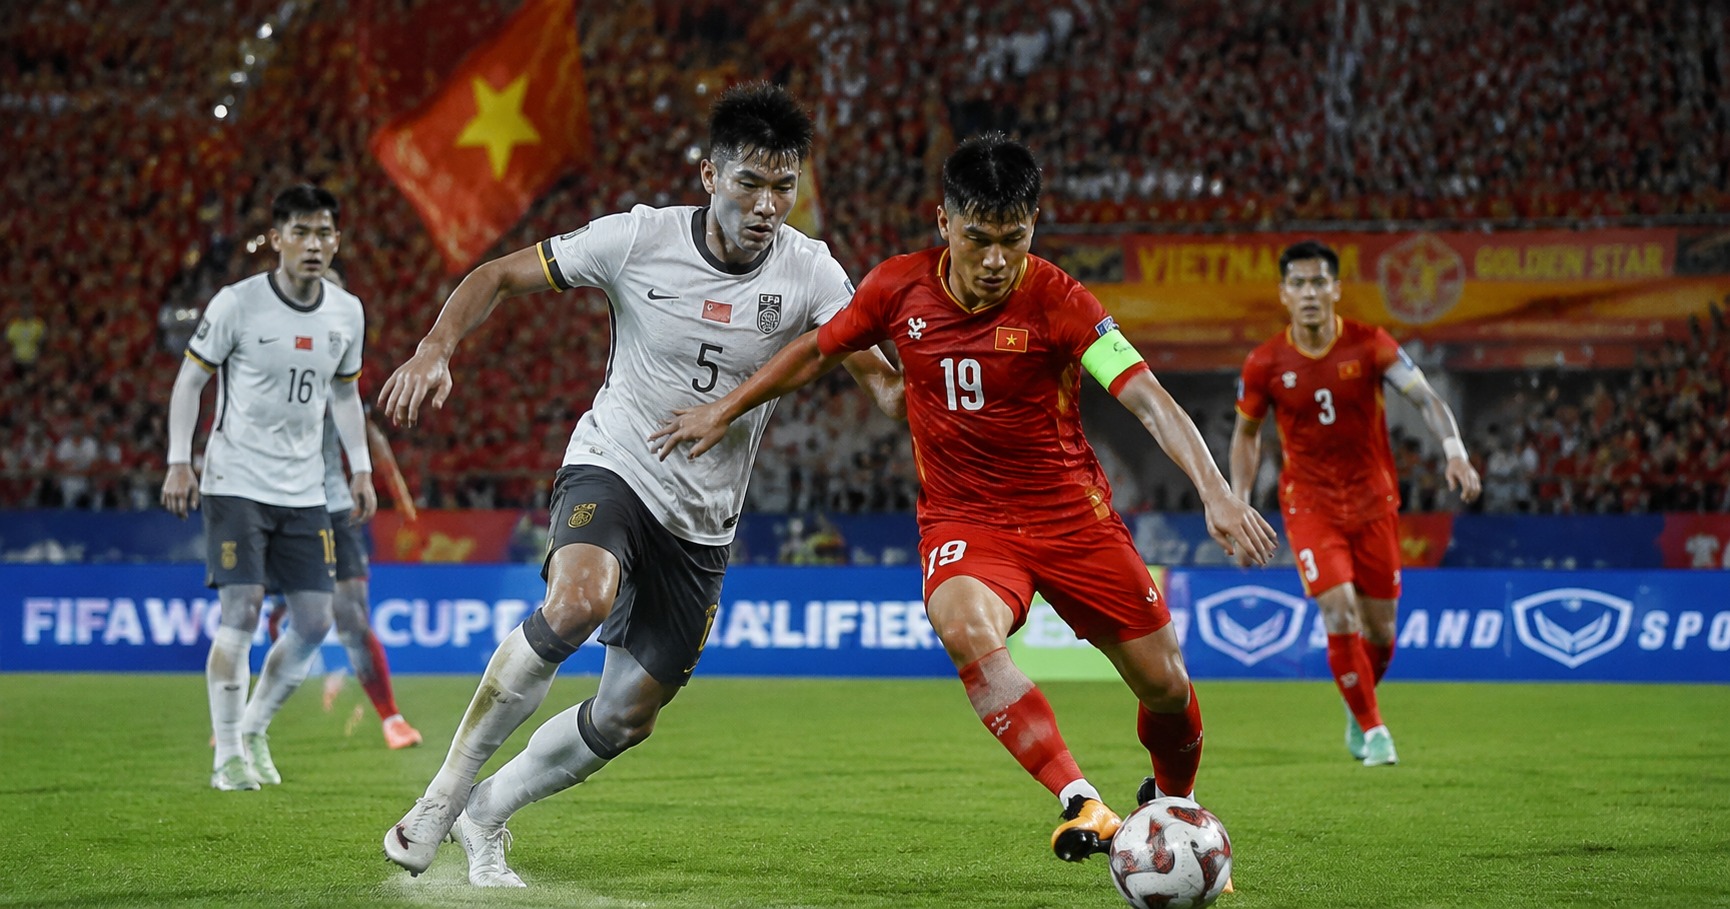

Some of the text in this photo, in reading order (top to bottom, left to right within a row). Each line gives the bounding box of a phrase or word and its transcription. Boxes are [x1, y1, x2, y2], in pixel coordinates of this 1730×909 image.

[1475, 245, 1585, 278] GOLDEN
[1592, 243, 1664, 278] STAR
[288, 367, 316, 404] 16
[692, 343, 723, 393] 5
[940, 358, 984, 410] 19
[1314, 388, 1336, 425] 3
[926, 539, 967, 580] 19
[1299, 548, 1319, 582] 3
[23, 597, 144, 645] FIFA
